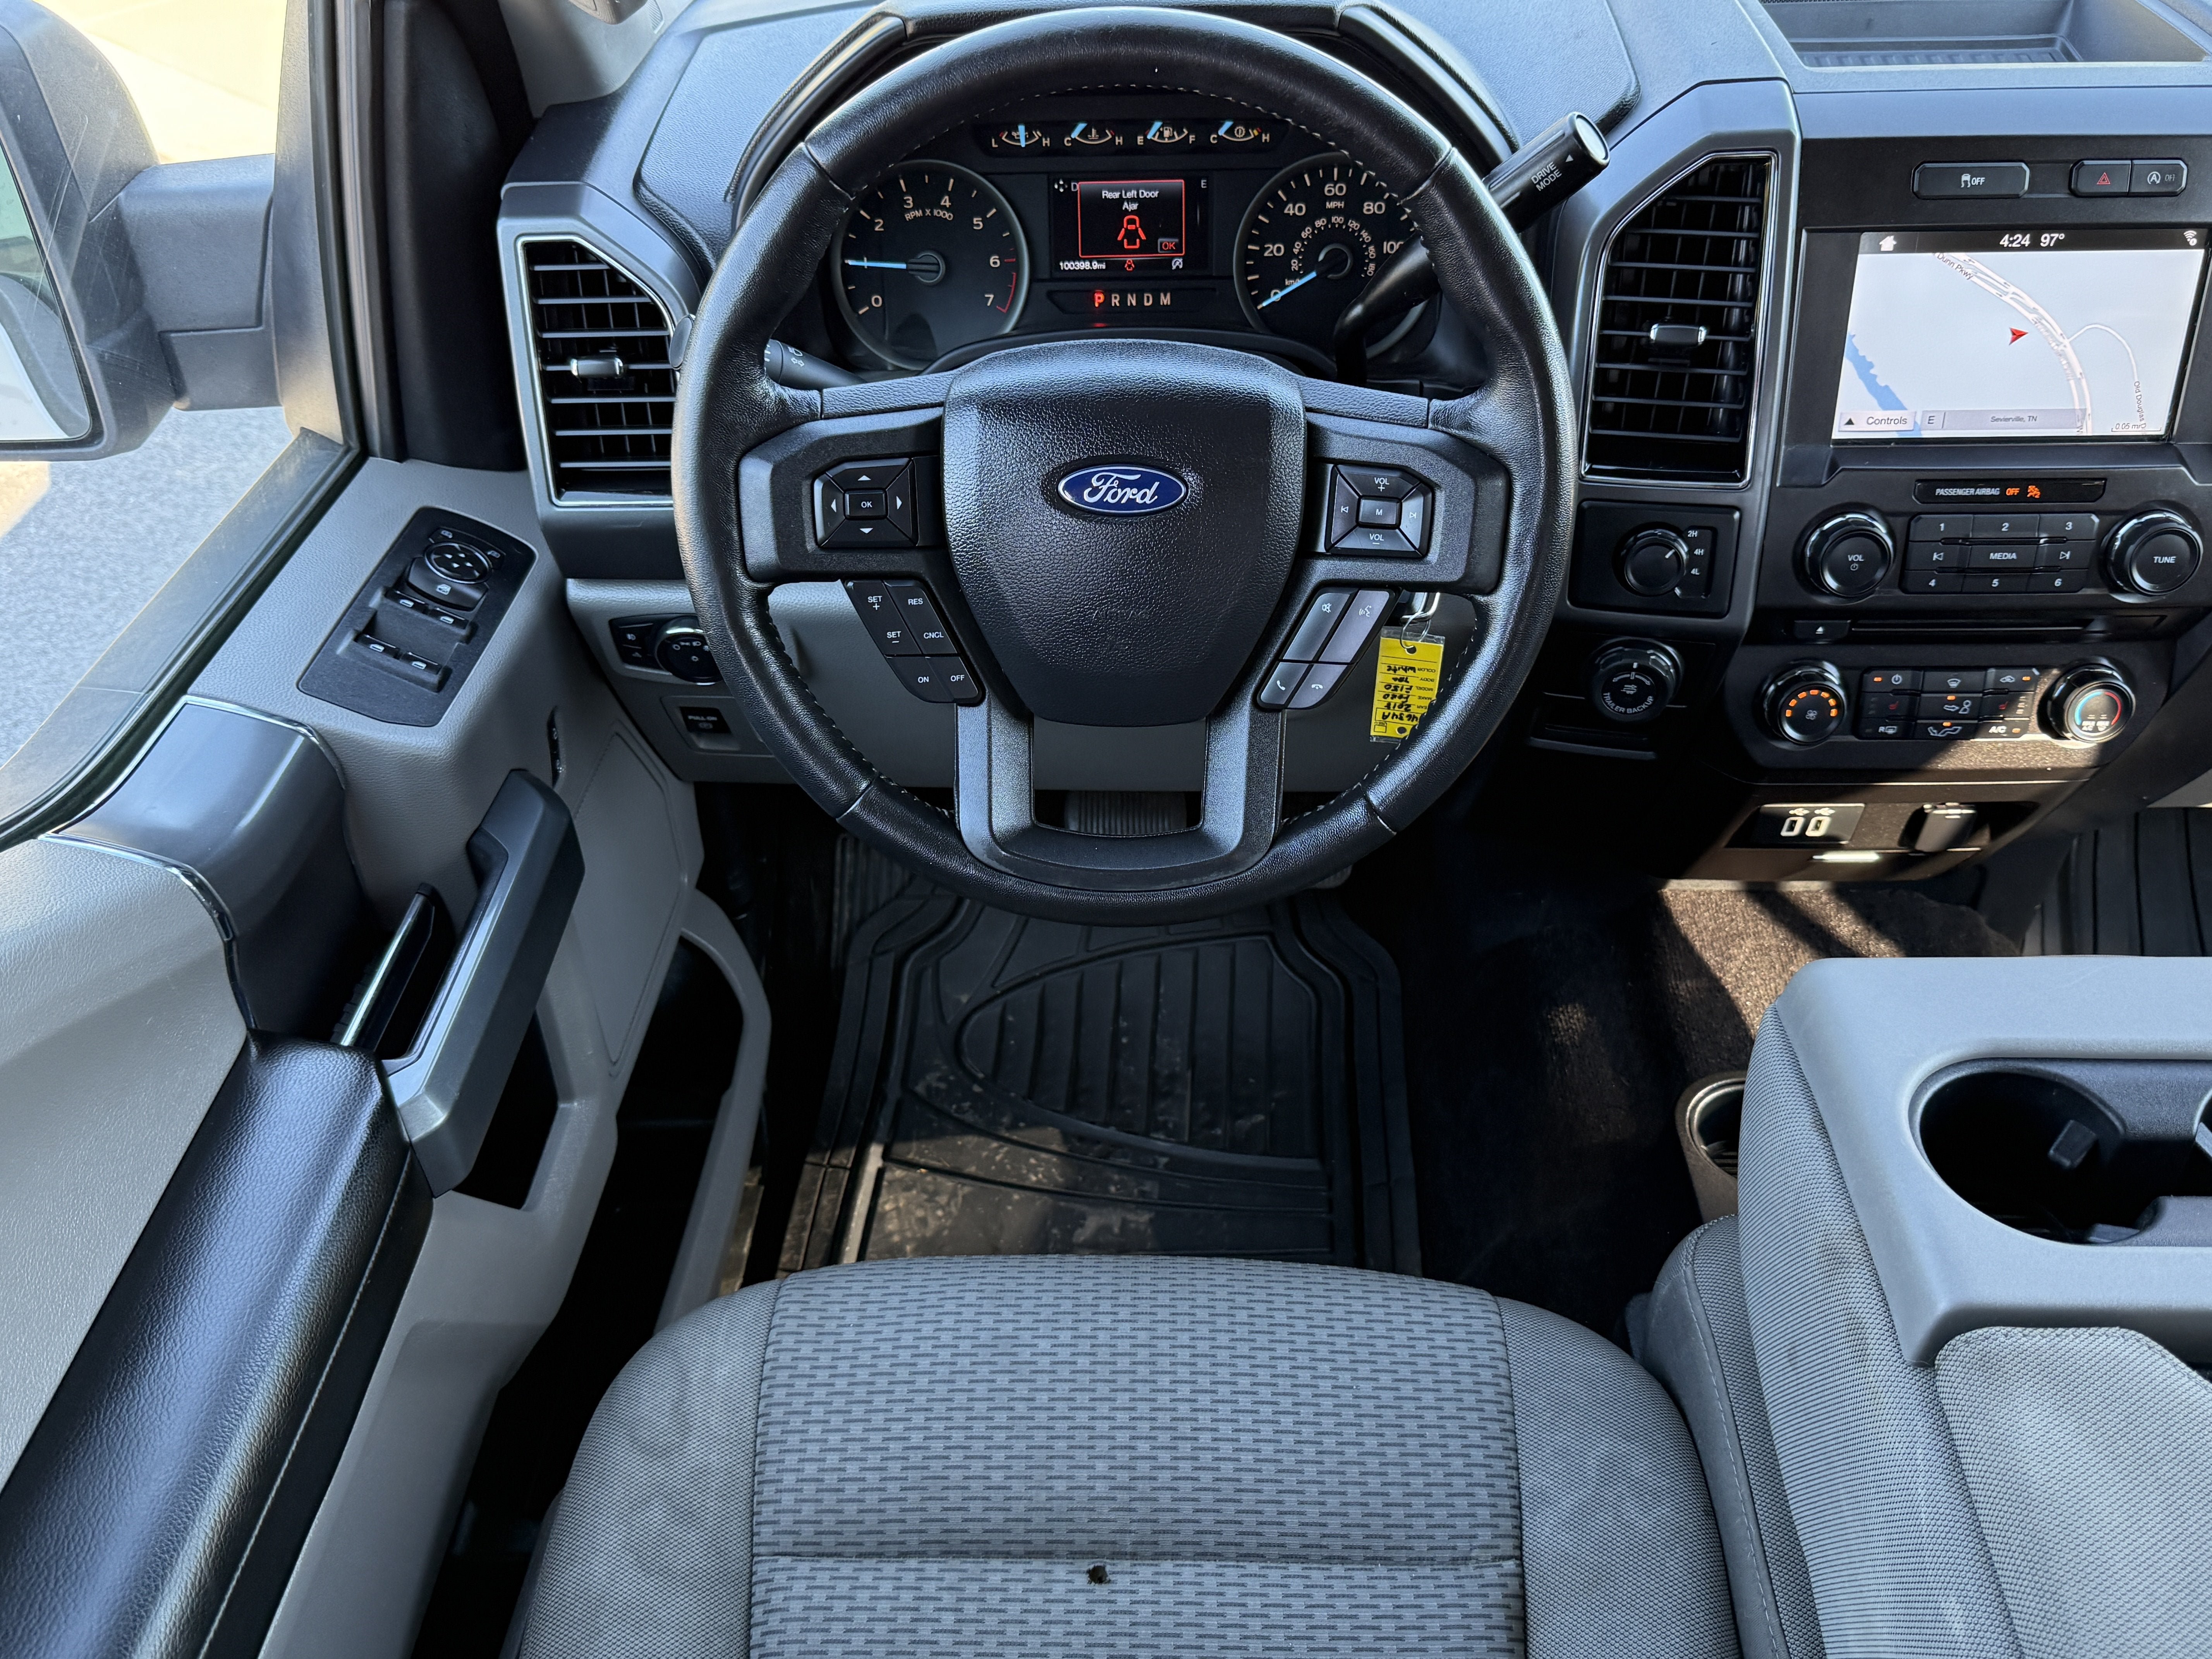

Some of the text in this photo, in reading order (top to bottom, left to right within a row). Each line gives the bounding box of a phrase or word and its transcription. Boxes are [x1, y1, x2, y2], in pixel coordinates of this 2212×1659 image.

[992, 138, 998, 148] L
[1042, 137, 1050, 147] H
[1064, 137, 1072, 146] C
[1115, 136, 1123, 145] H
[1137, 136, 1144, 145] E
[1189, 135, 1195, 144] F
[1210, 135, 1218, 144] C
[1262, 134, 1269, 143] H
[1531, 162, 1557, 184] DRIVE
[1201, 179, 1207, 188] E
[1535, 169, 1562, 191] MODE
[1971, 177, 1985, 185] OFF
[1102, 189, 1159, 199] Rear Left Door
[1324, 184, 1346, 196] 60
[903, 196, 914, 208] 3
[941, 196, 951, 208] 4
[1122, 202, 1139, 211] Ajar
[1284, 203, 1306, 216] 40
[1363, 202, 1385, 214] 80
[905, 210, 923, 221] RPM
[933, 210, 953, 221] 1000
[874, 219, 884, 231] 2
[973, 218, 983, 230] 5
[1315, 218, 1326, 227] 80
[1348, 220, 1360, 230] 120
[1301, 227, 1312, 238] 60
[1360, 230, 1371, 242] 140
[1162, 242, 1176, 250] OK
[1999, 234, 2031, 247] 4:24
[1264, 244, 1285, 256] 20
[1293, 242, 1302, 254] 40
[990, 256, 1000, 267] 6
[1291, 259, 1298, 271] 20
[1937, 252, 1973, 280] Dunn Pkwy
[871, 295, 883, 307] 0
[985, 294, 994, 306] 7
[1094, 292, 1171, 307] P R N D M
[2136, 394, 2144, 422] Douglas
[1867, 416, 1907, 425] Controls
[1928, 416, 1936, 424] E
[1084, 472, 1160, 504] Ford
[2001, 523, 2009, 531] 2
[2065, 522, 2072, 530] 3
[1992, 579, 1999, 587] 5
[2055, 579, 2062, 587] 6
[1603, 692, 1654, 713] TRAILER BACKUP
